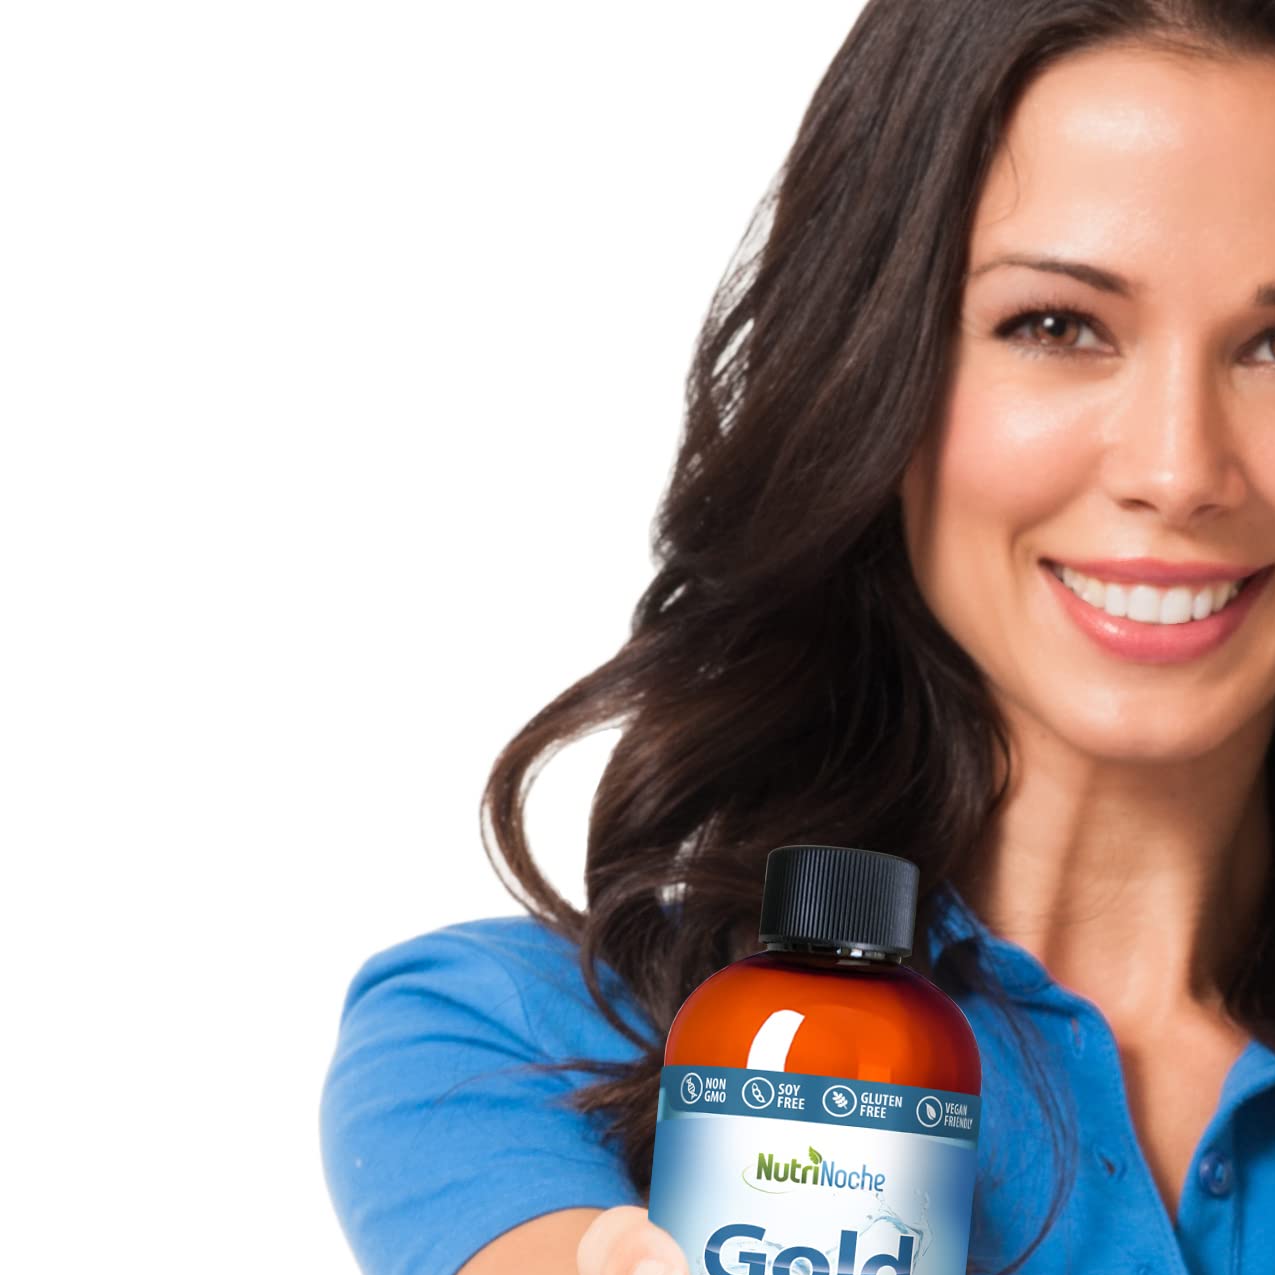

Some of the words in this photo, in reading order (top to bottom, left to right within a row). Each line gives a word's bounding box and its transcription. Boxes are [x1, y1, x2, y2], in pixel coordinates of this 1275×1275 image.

[705, 1078, 726, 1090] NON
[778, 1083, 800, 1096] SOY
[704, 1090, 726, 1103] GMO
[777, 1096, 805, 1110] FREE
[860, 1092, 903, 1107] GLUTEN
[860, 1104, 887, 1119] FREE
[945, 1102, 968, 1116] VEGAN
[756, 1150, 886, 1192] NutriNoche
